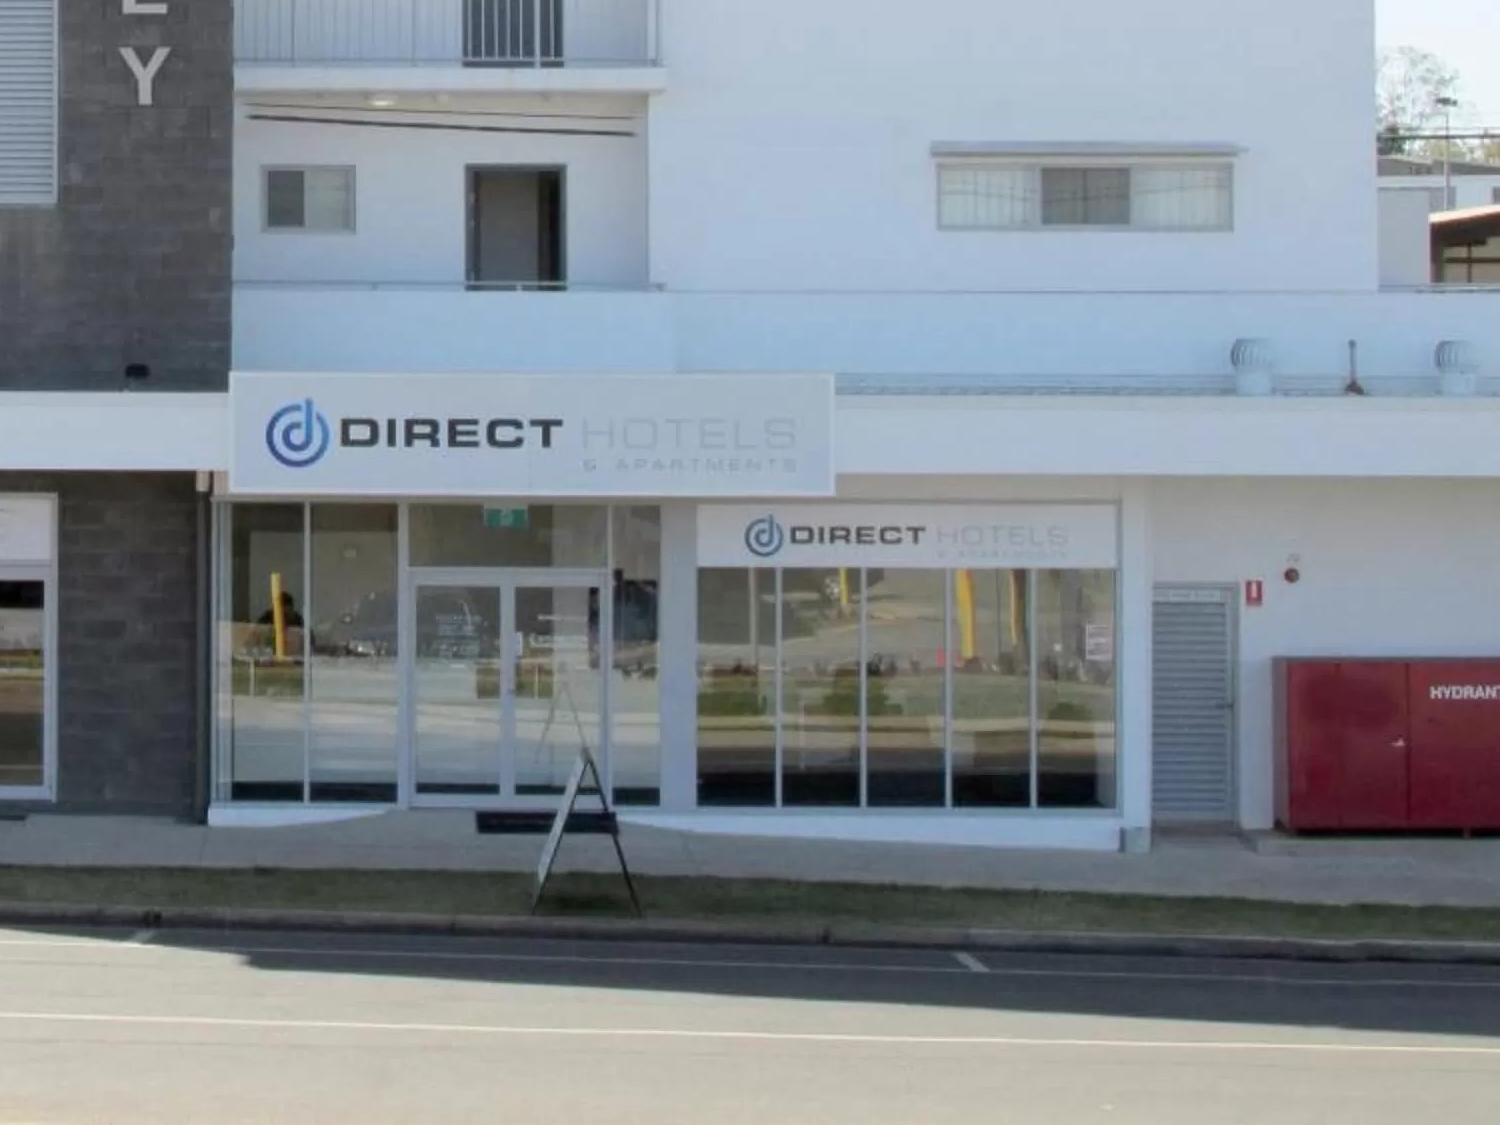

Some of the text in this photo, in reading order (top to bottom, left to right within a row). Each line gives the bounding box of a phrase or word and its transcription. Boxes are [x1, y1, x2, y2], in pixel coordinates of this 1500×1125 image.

[339, 418, 564, 448] DIRECT
[581, 418, 797, 450] HOTELS
[789, 526, 926, 545] DIRECT
[936, 525, 1068, 546] HOTELS
